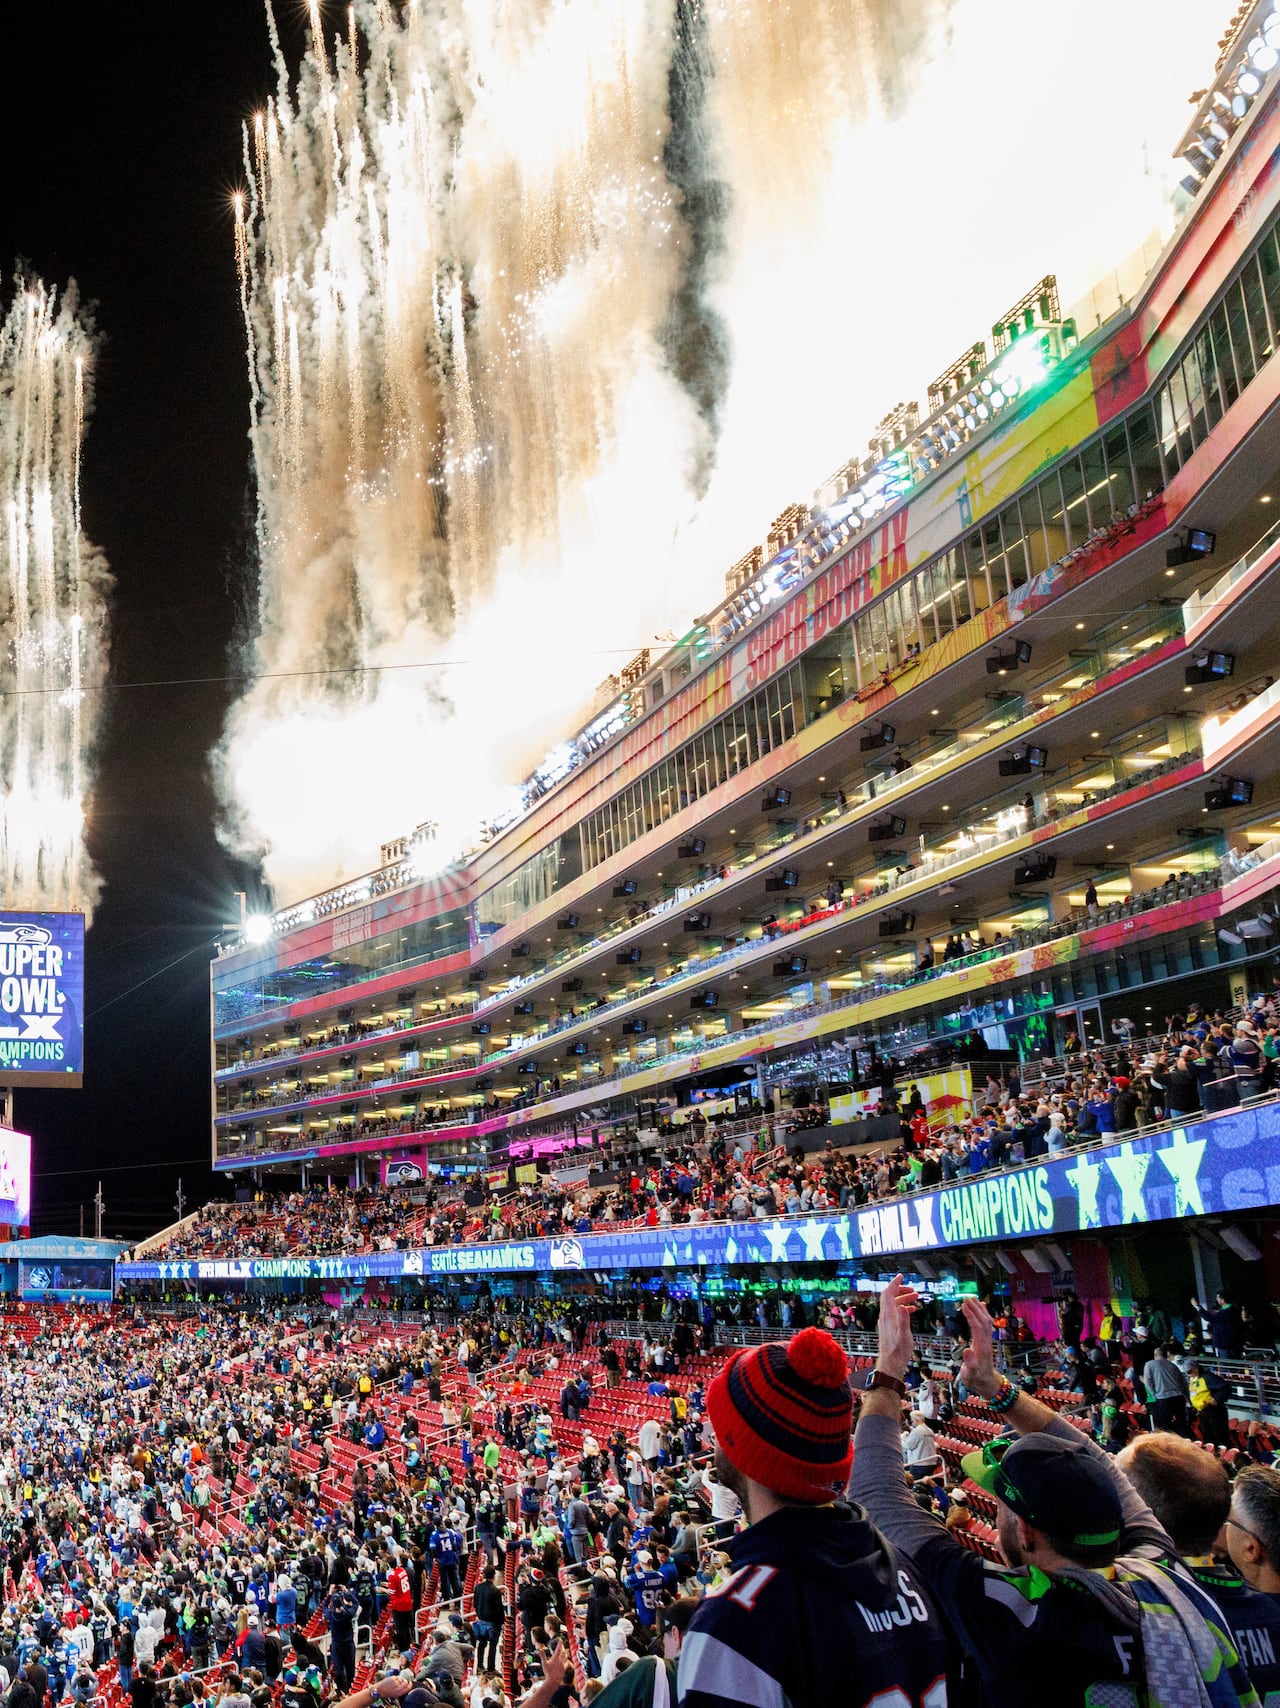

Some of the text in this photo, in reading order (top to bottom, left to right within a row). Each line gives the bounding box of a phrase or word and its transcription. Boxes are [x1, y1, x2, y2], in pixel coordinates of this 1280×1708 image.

[747, 508, 909, 690] SUPER BOWL LX
[900, 1197, 938, 1249] LX
[939, 1167, 1054, 1243] CHAMPIONS
[68, 1245, 98, 1257] LX
[431, 1246, 534, 1271] SEATTLE SEAHAWKS
[229, 1262, 252, 1277] LX
[254, 1260, 311, 1277] CHAMPIONS
[440, 1538, 453, 1552] 14
[236, 1581, 244, 1593] 0
[257, 1588, 266, 1600] 12
[80, 1638, 88, 1650] 11
[1235, 1627, 1276, 1667] FAN
